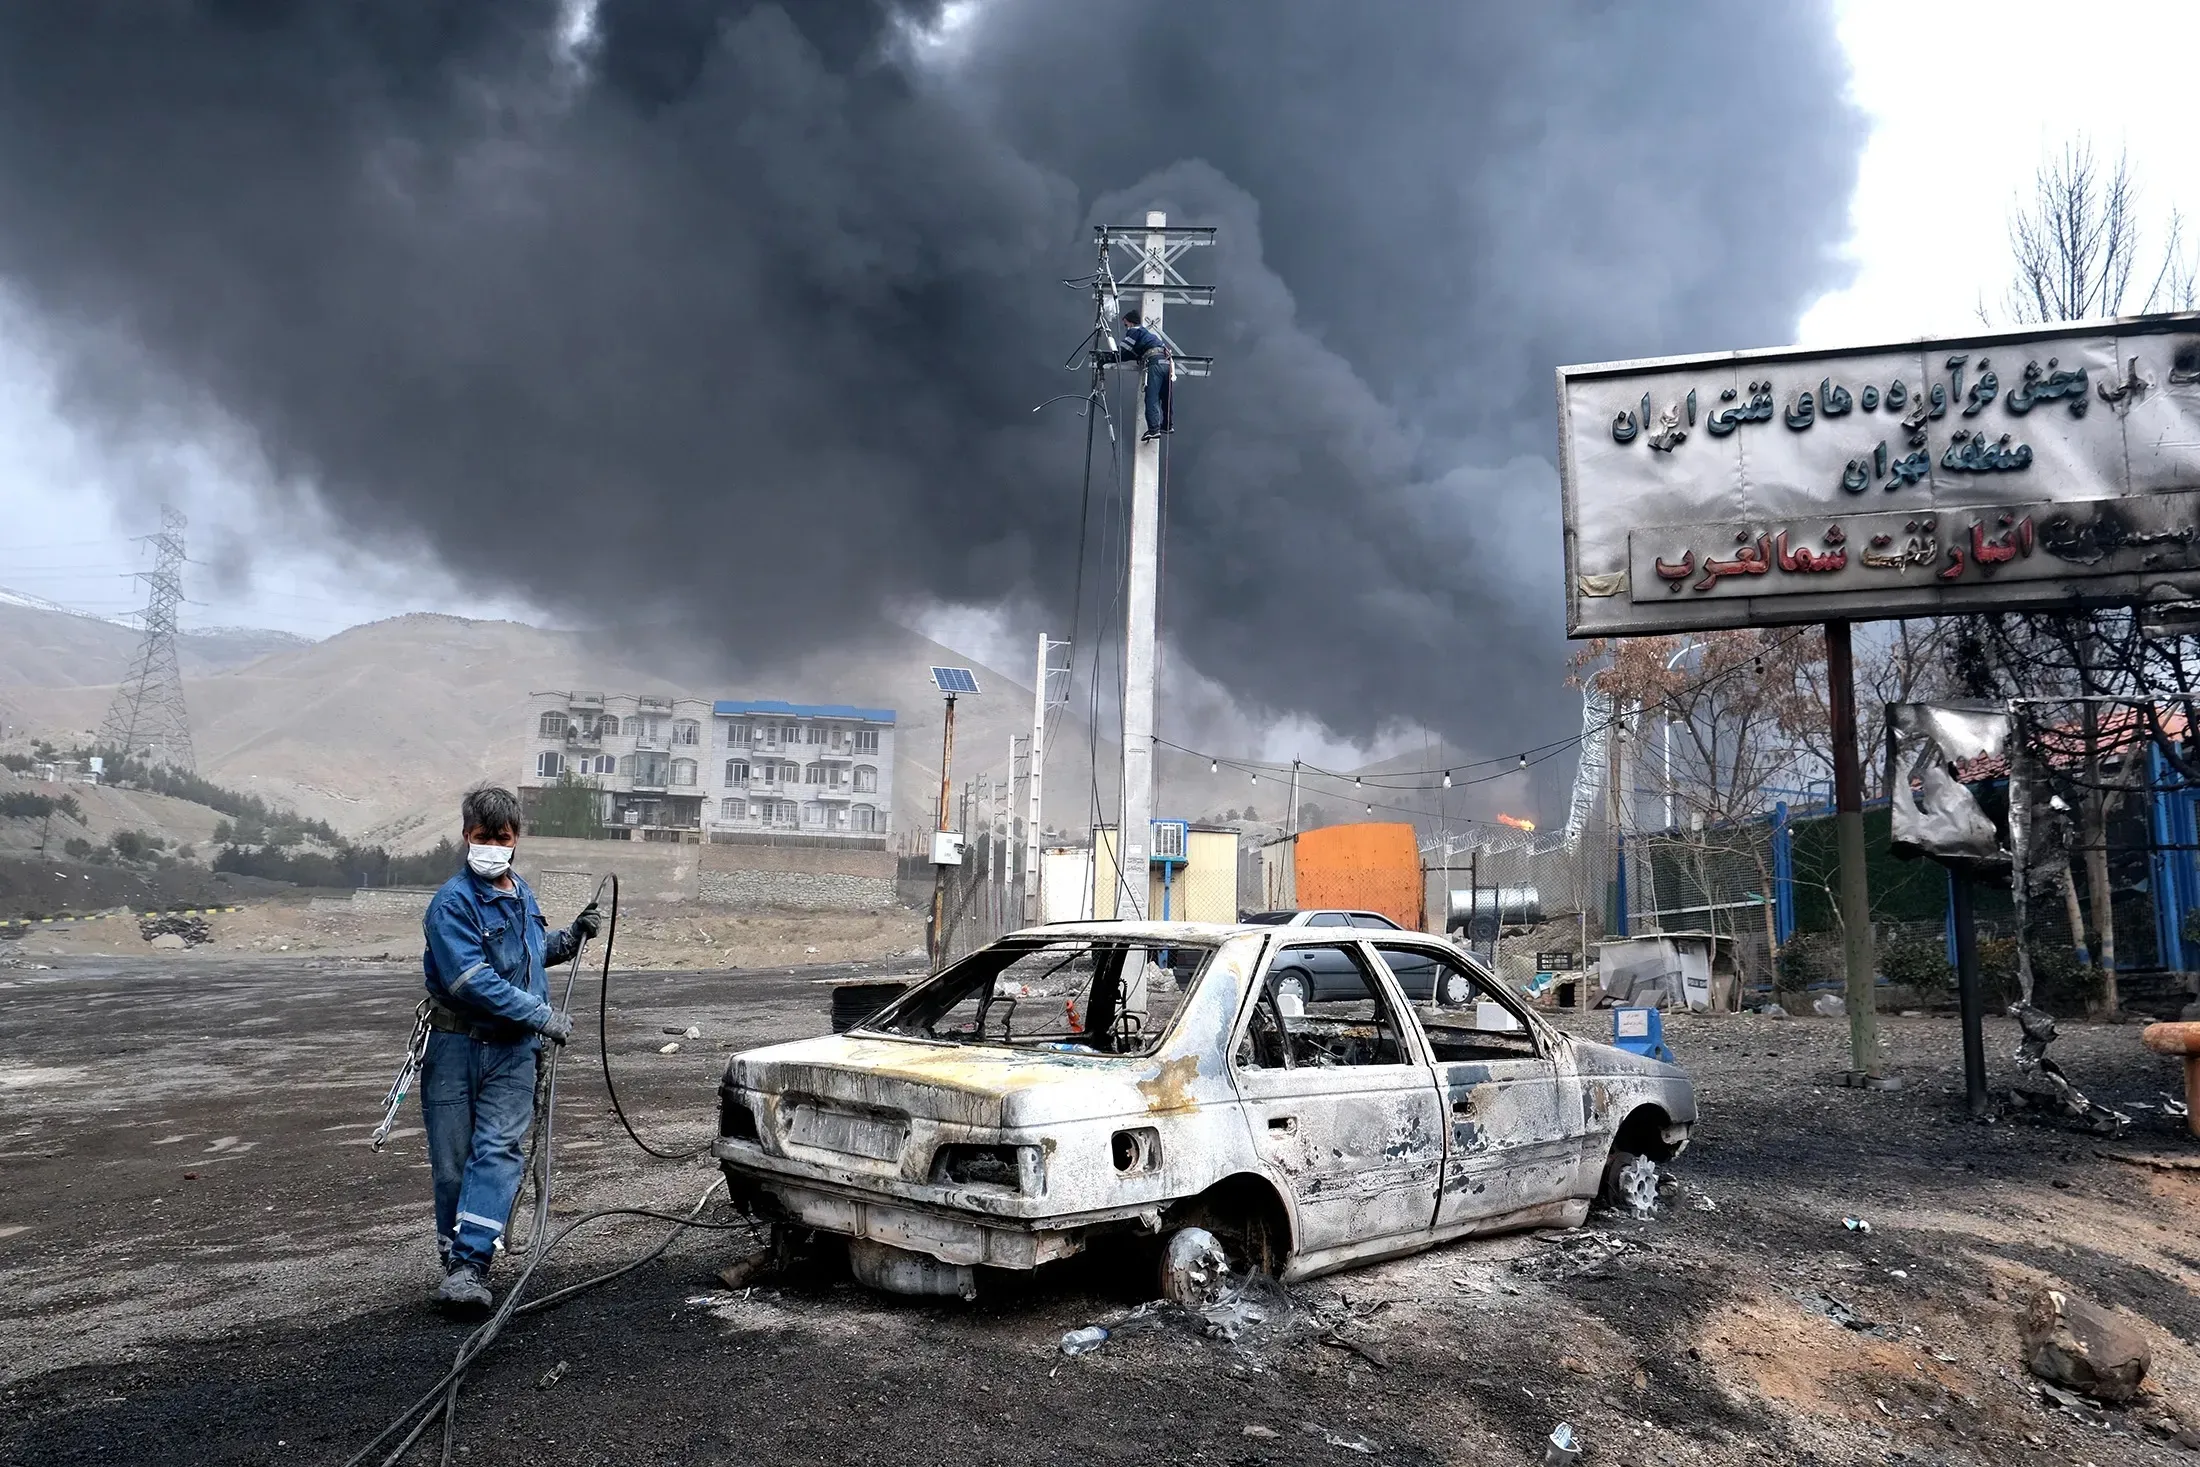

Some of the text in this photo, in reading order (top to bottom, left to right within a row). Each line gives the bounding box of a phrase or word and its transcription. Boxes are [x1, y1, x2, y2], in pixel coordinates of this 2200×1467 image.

[1706, 380, 1774, 437] نفتی
[1785, 376, 1853, 431] های
[2006, 356, 2090, 420] پخش
[1842, 429, 2034, 492] منطقه تهران
[1861, 519, 1938, 576] نفت
[1936, 511, 2034, 580] انبار
